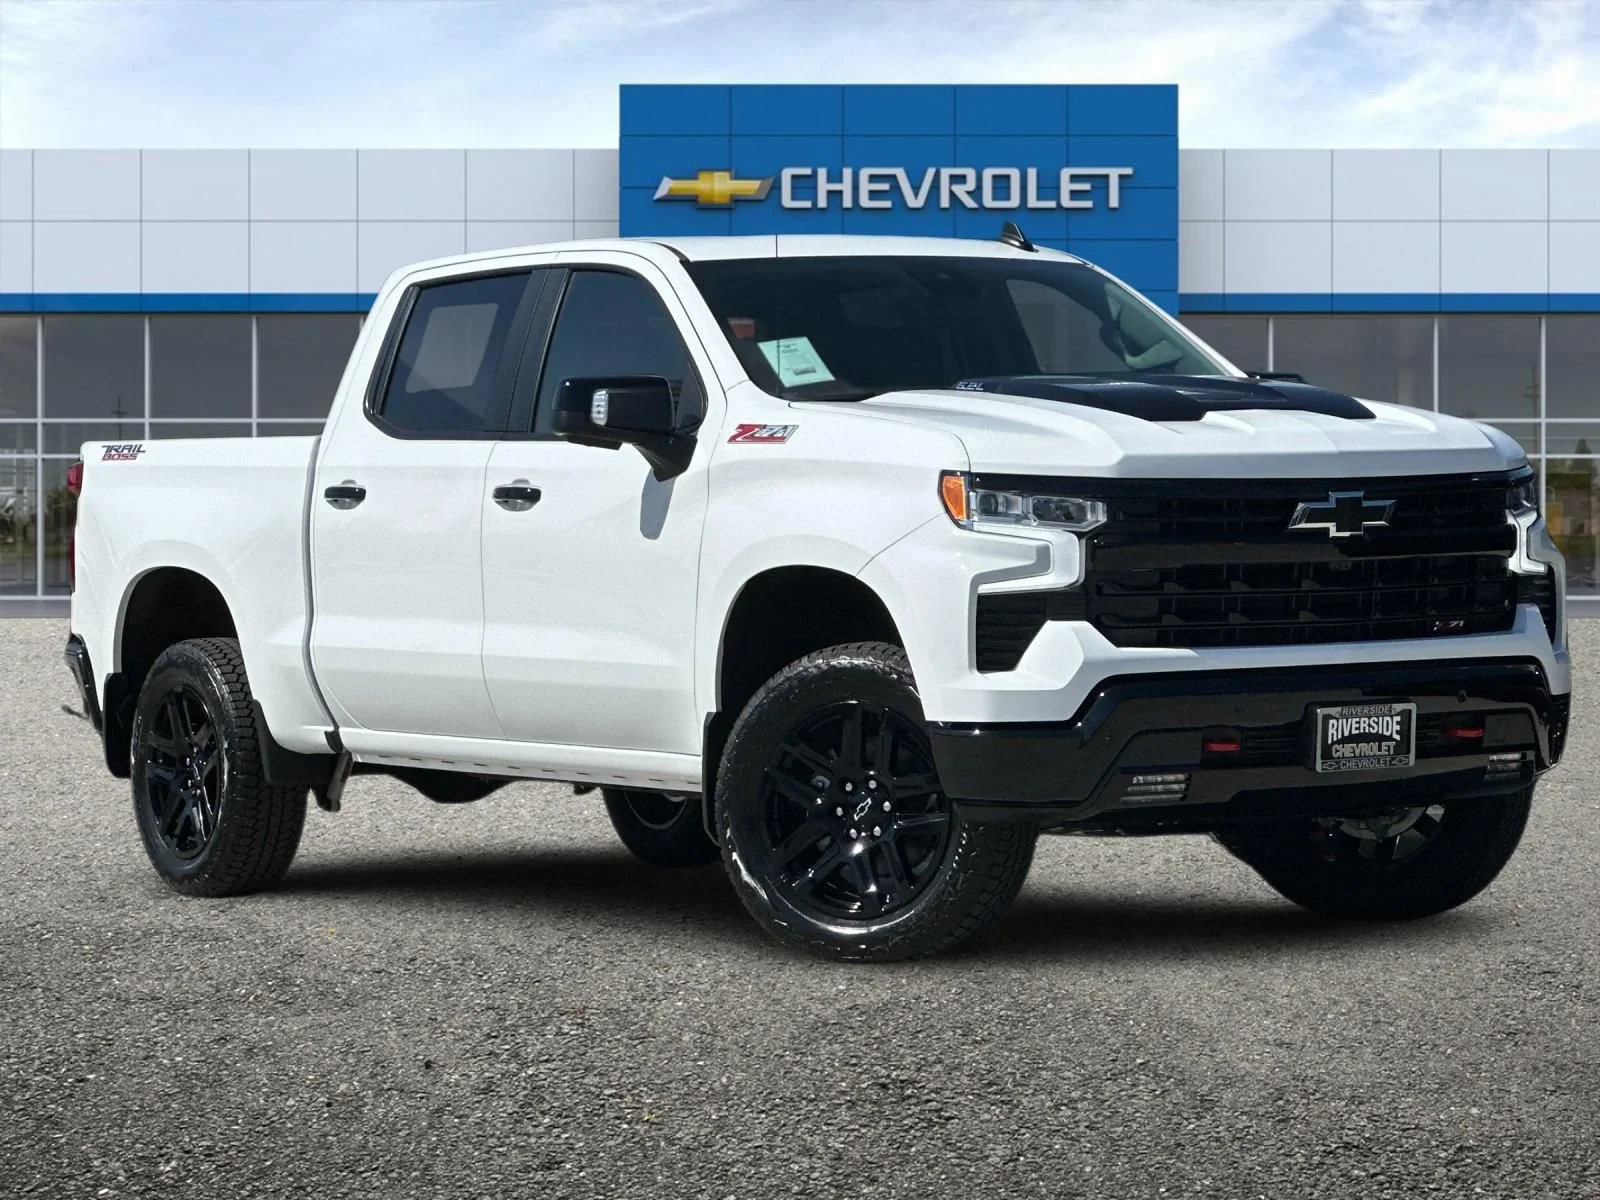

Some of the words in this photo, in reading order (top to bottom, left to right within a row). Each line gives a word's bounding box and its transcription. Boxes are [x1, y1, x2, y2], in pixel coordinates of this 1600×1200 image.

[780, 167, 1133, 209] CHEVROLET
[727, 424, 799, 444] Z71
[102, 444, 146, 453] TRAIL
[102, 453, 138, 461] BOSS
[1342, 705, 1390, 716] RIVERSIDE
[1328, 716, 1401, 744] RIVERSIDE
[1331, 741, 1396, 758] CHEVROLET
[1340, 758, 1392, 769] CHEVROLET
